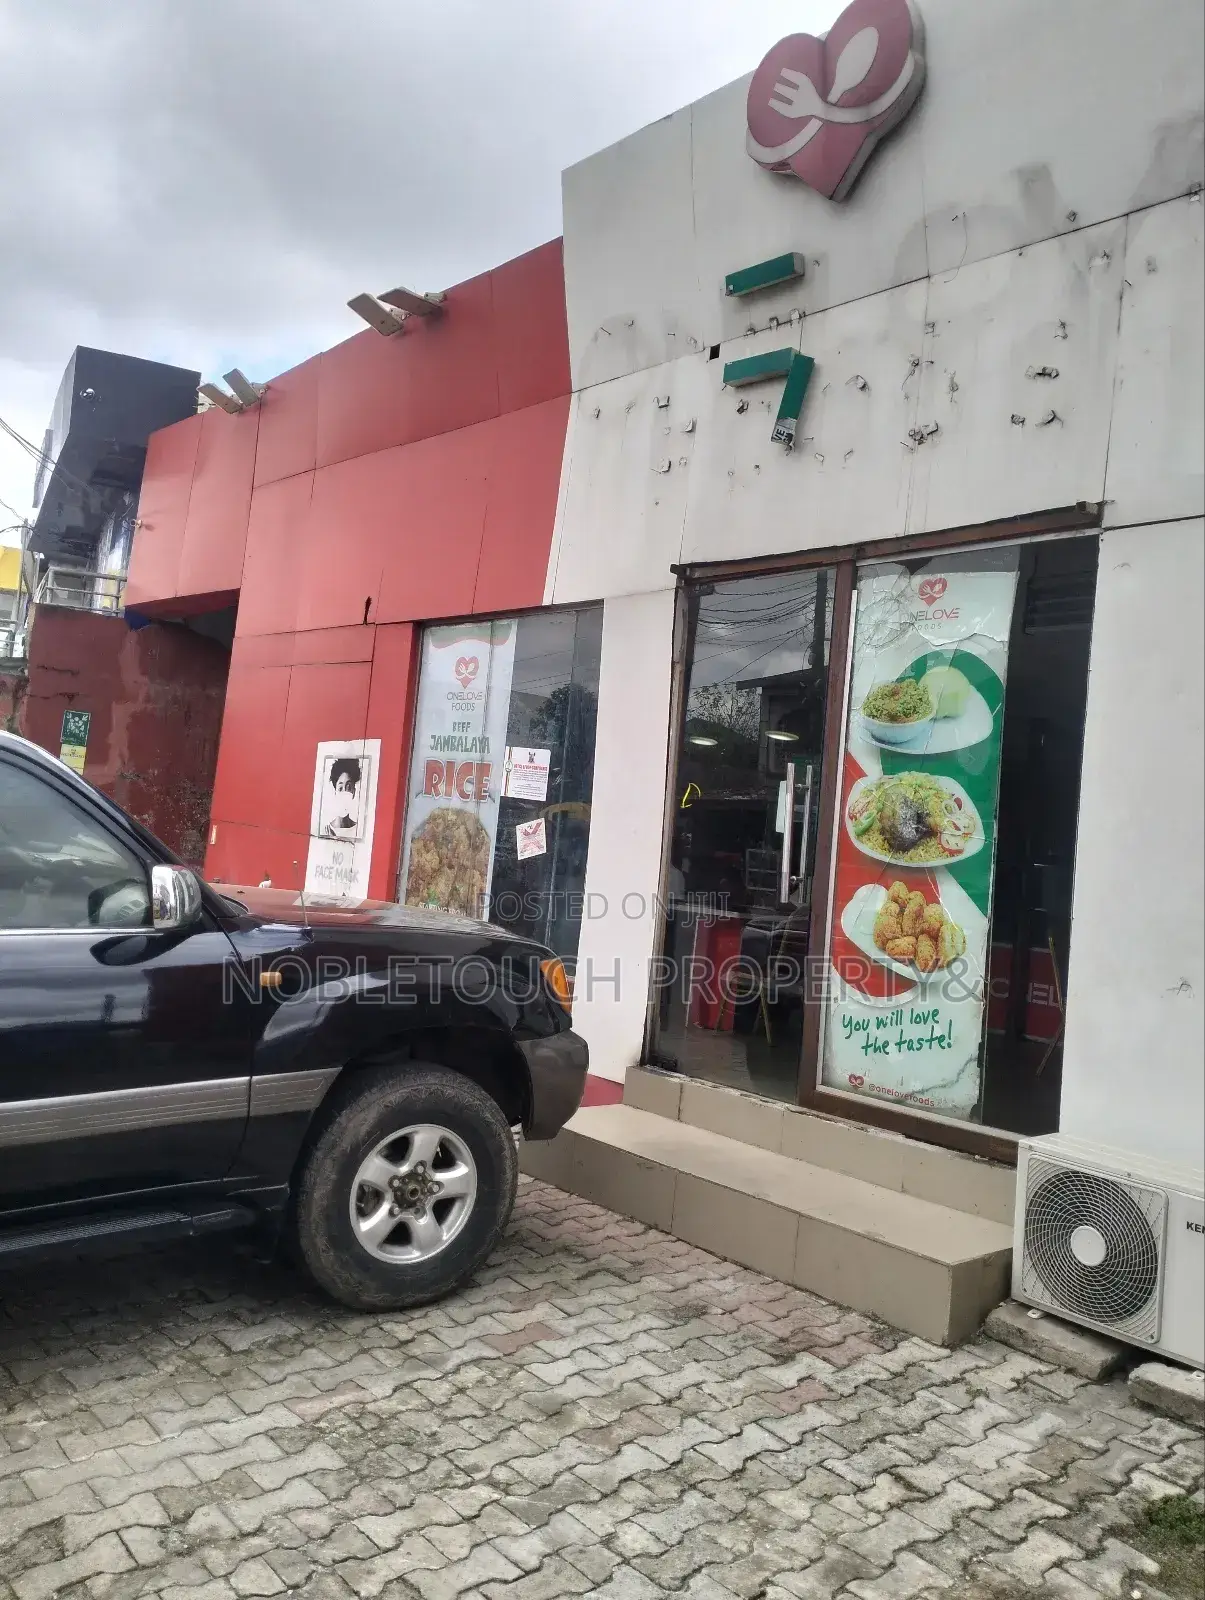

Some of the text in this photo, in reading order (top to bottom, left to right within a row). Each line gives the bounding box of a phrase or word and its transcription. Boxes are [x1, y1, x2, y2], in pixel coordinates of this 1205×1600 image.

[900, 607, 960, 621] ONELOVE
[446, 691, 483, 701] ONELOVE
[451, 702, 476, 712] FOODS
[452, 721, 472, 732] BEEF
[429, 734, 491, 754] JAMBALAYA
[423, 758, 493, 803] RICE
[332, 851, 344, 865] NO
[314, 865, 361, 884] FACE MASK
[876, 1008, 903, 1031] will
[909, 1007, 940, 1026] love
[861, 1018, 953, 1057] the taste!
[868, 1083, 935, 1107] @onelovefoods
